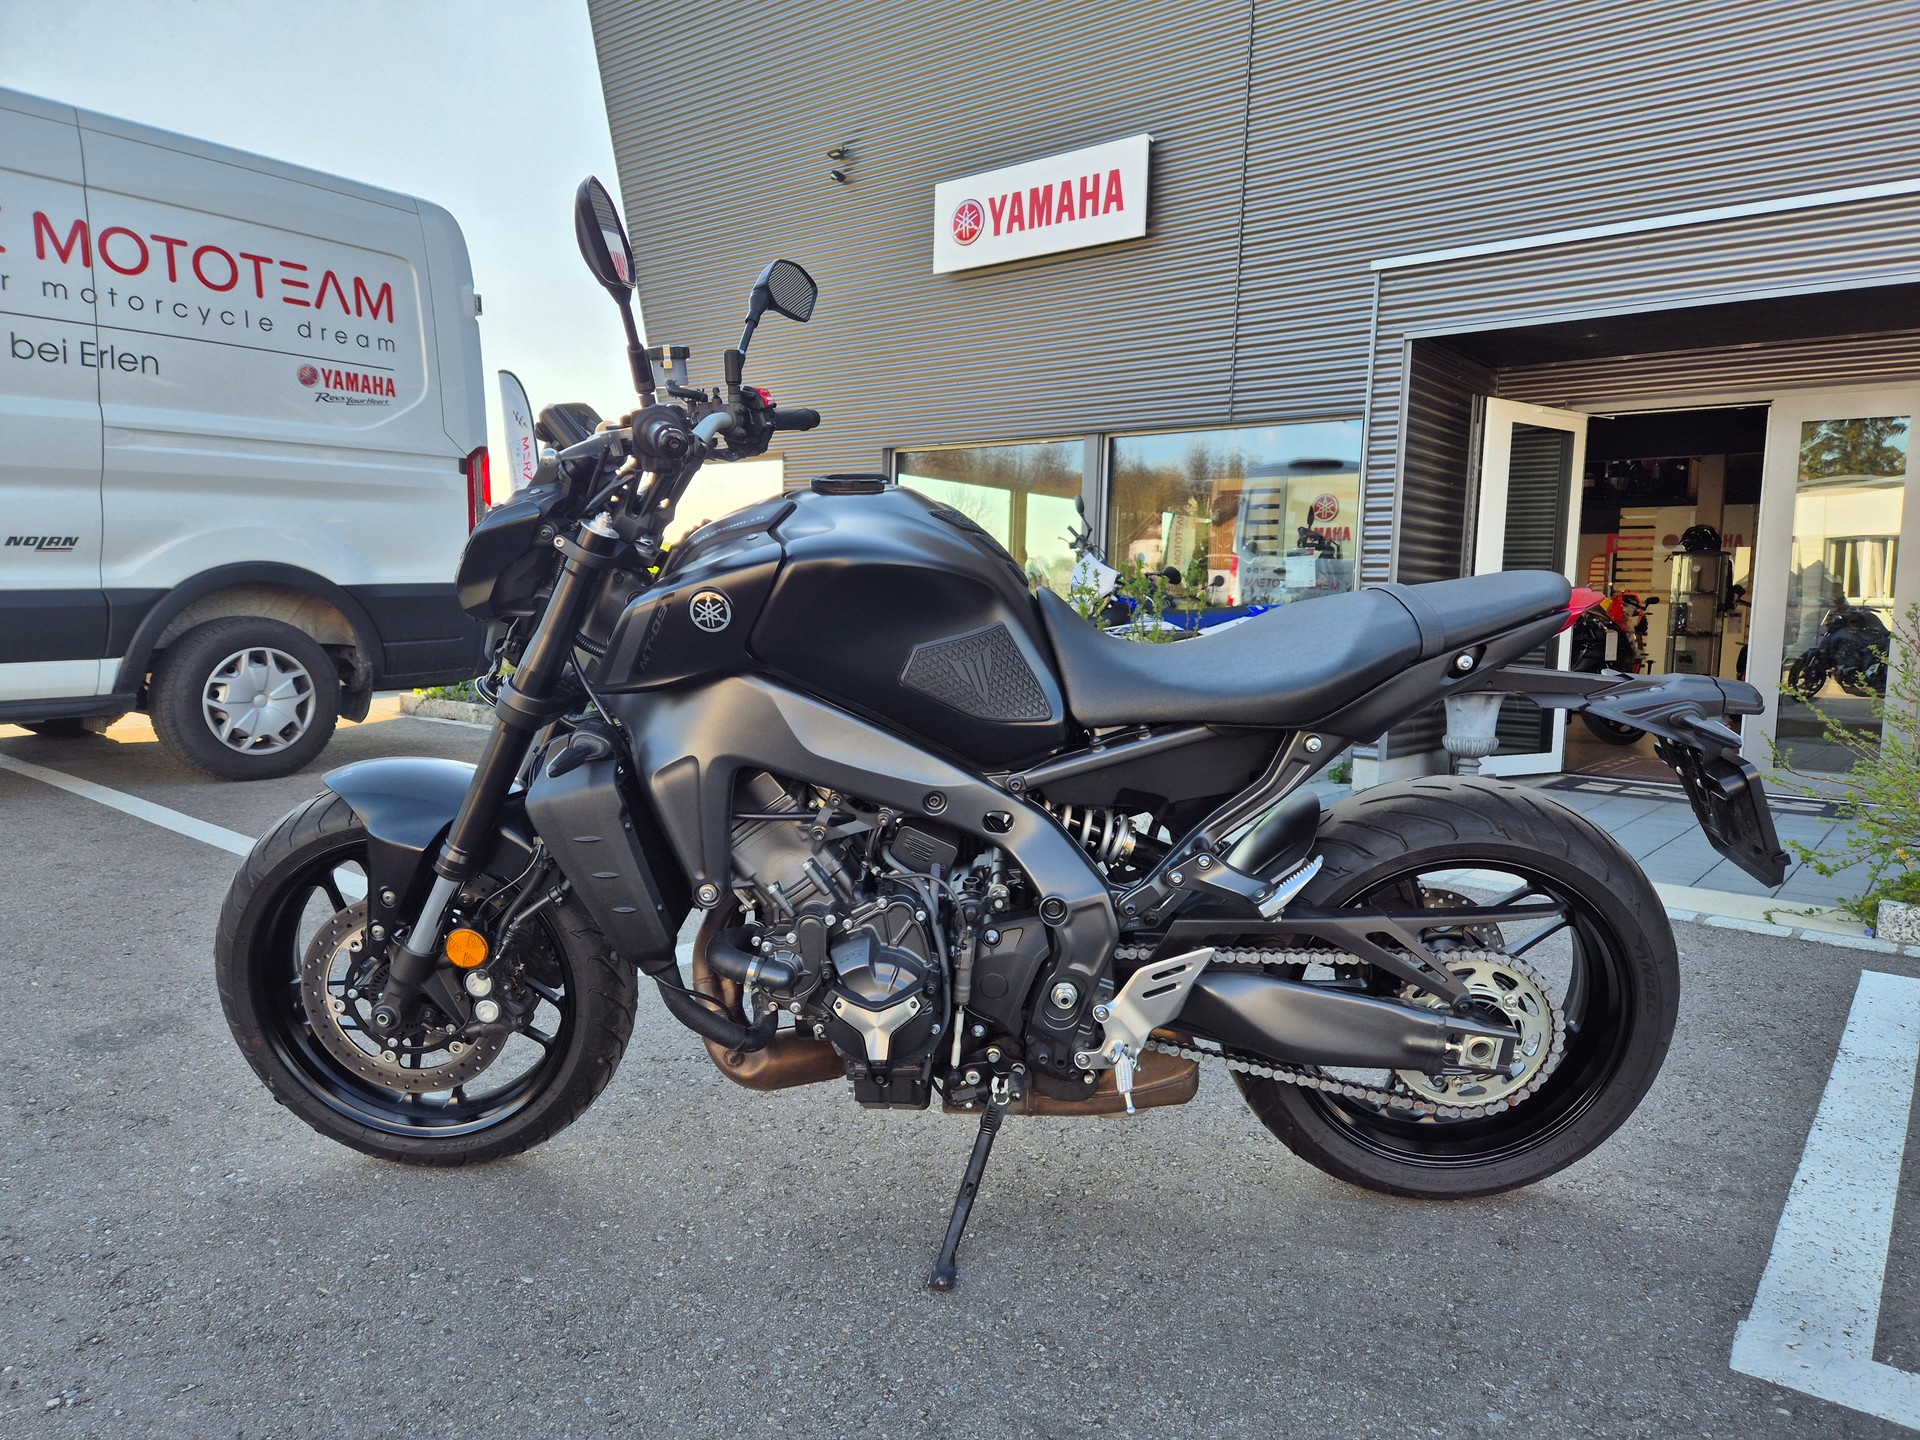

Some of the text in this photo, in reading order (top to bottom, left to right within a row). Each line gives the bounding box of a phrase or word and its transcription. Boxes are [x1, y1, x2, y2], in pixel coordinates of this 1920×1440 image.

[988, 168, 1125, 237] YAMAHA
[32, 210, 394, 324] MOTOTEAM
[41, 280, 274, 332] motorcycle
[297, 320, 396, 353] dream
[10, 331, 160, 375] bei Erlen
[320, 367, 397, 398] YAMAHA
[4, 536, 80, 551] NOLAN
[640, 602, 668, 670] MT-09
